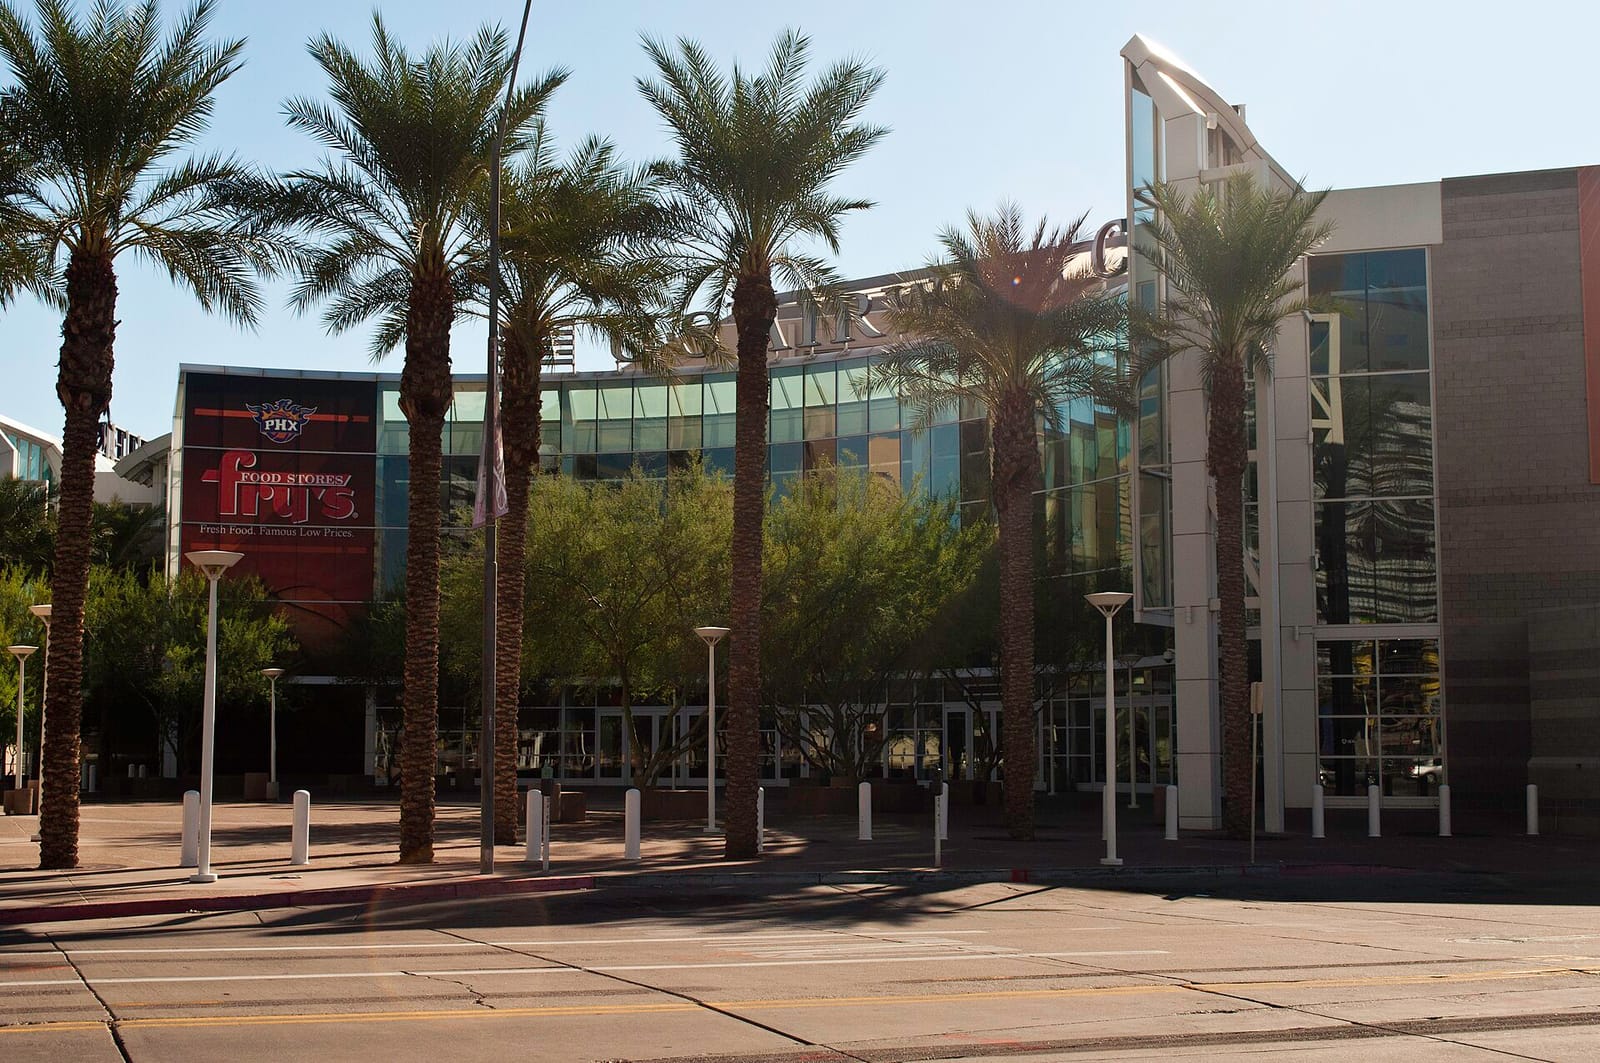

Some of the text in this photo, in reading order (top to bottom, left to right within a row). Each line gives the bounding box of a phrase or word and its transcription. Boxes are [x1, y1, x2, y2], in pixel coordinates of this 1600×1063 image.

[265, 419, 298, 431] PHX
[241, 471, 345, 485] FOOD STORES
[200, 524, 355, 538] Fresh Food. Famous Low Prices.
